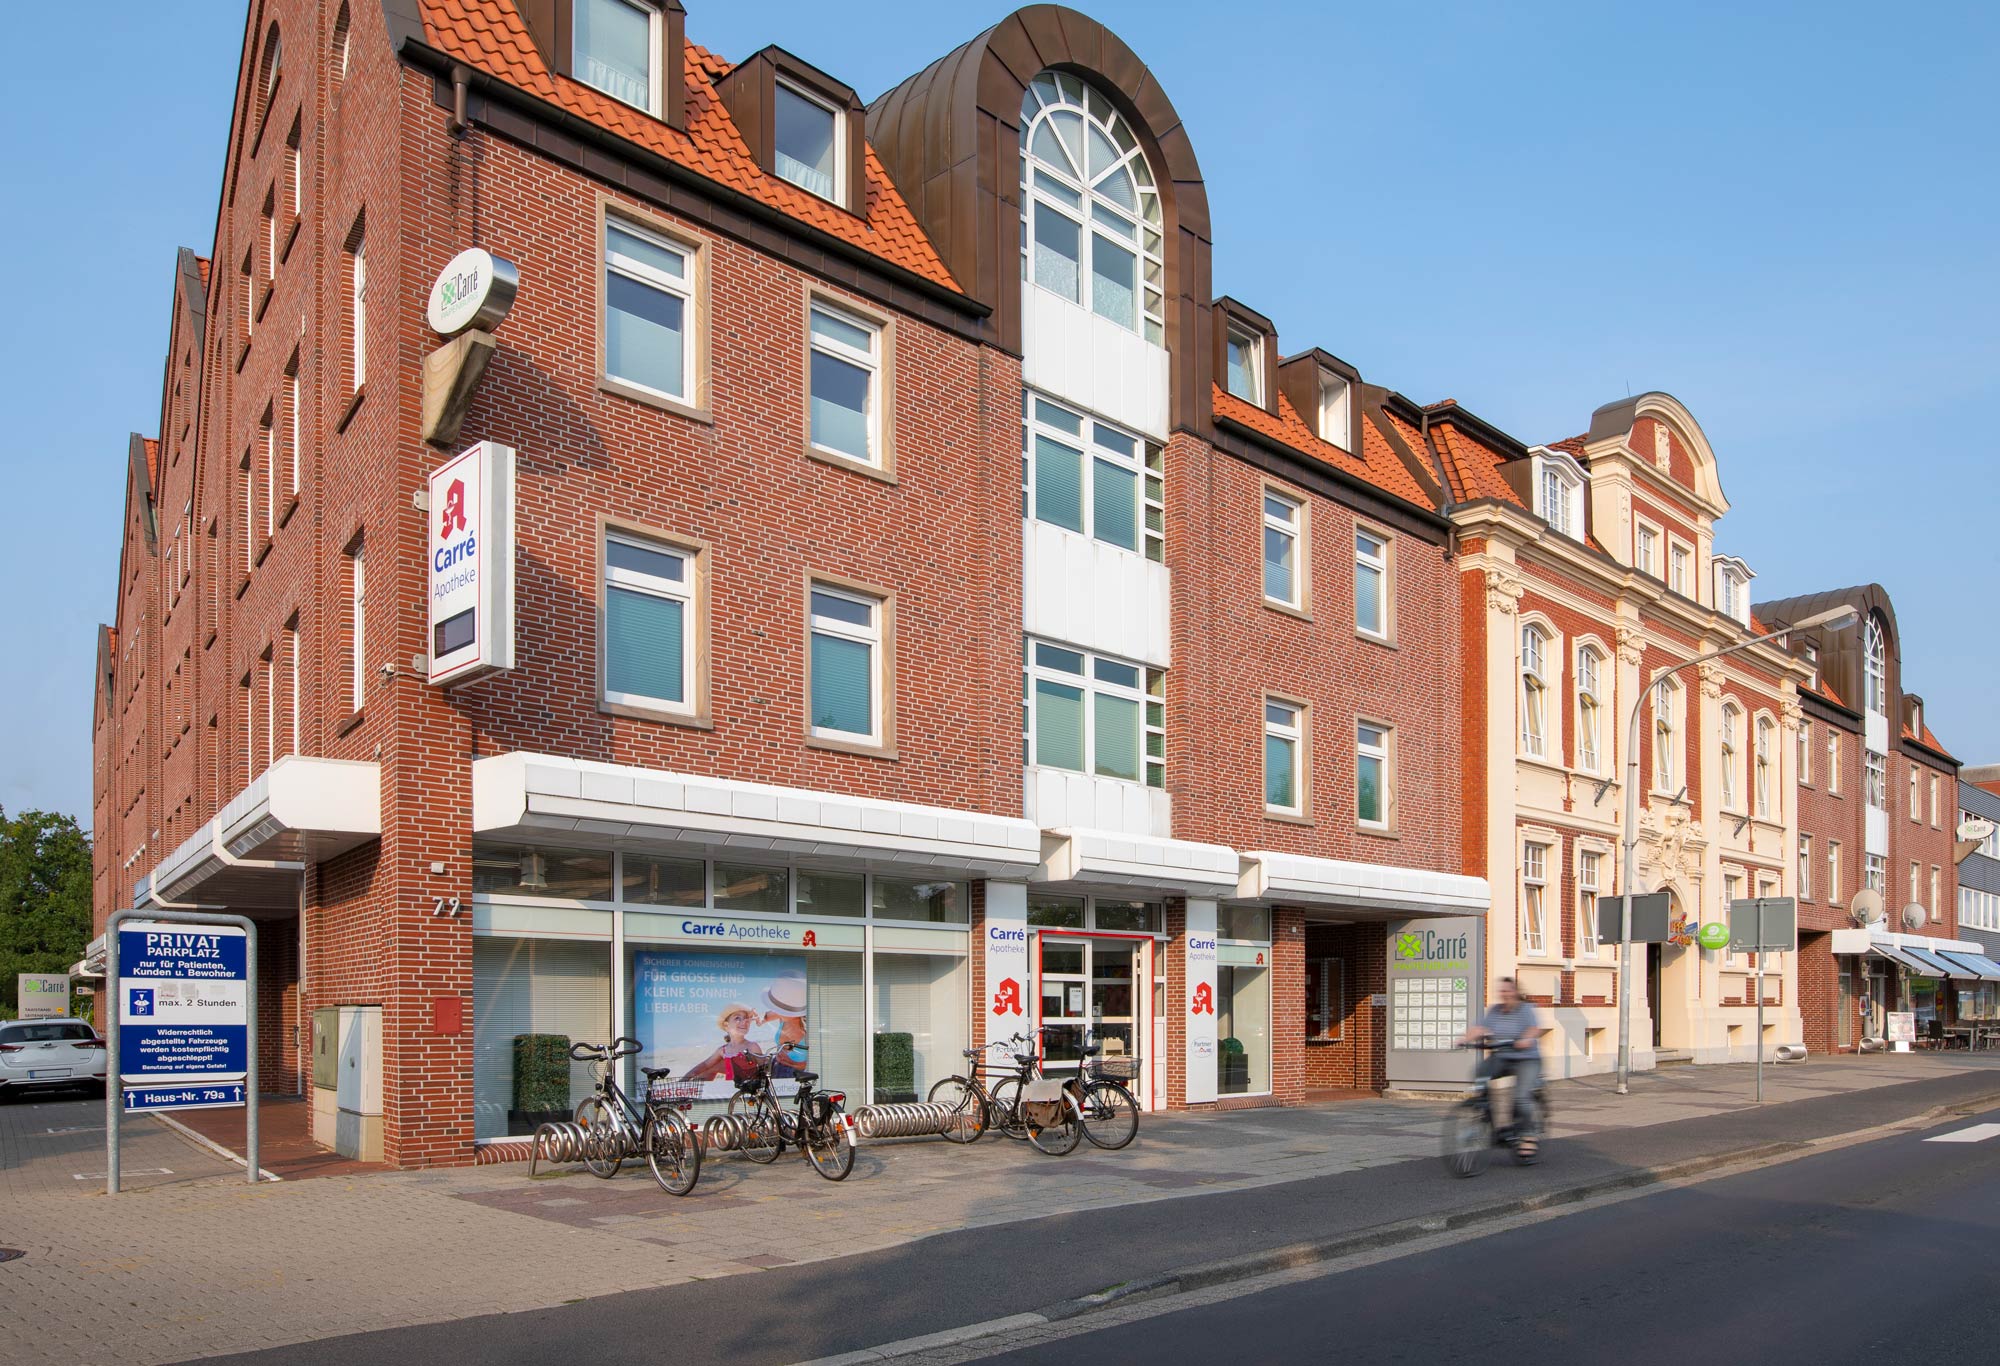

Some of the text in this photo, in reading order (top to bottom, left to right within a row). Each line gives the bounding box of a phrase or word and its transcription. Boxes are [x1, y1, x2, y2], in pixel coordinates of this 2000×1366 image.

[457, 265, 478, 301] Carré
[434, 530, 476, 573] Carré
[434, 567, 476, 600] Apotheke
[432, 896, 460, 917] 79
[681, 921, 791, 941] Carré Apotheke
[990, 927, 1025, 941] Carré
[146, 933, 221, 949] PRIVAT
[1189, 937, 1216, 950] Carré
[1426, 930, 1467, 960] Carré
[147, 947, 220, 958] PARKPLATZ
[989, 944, 1025, 955] Apotheke
[643, 957, 745, 969] SICHERER SONNENSCHUTZ
[1189, 952, 1216, 961] Apotheke
[140, 960, 226, 971] nur für Patienten,
[133, 967, 172, 976] Kunden
[188, 969, 236, 978] Bewohner
[644, 969, 745, 984] FÜR GROSSE UND
[42, 979, 65, 993] Carré
[644, 986, 742, 999] KLEINE SONNEN-
[159, 999, 237, 1007] max. 2 Stunden
[645, 1001, 709, 1014] LIEBHABER
[157, 1028, 213, 1036] Widerrechtlich
[141, 1037, 228, 1046] abgestellte Fahrzeuge
[172, 1045, 230, 1054] kostenpflichtig
[157, 1054, 213, 1063] abgeschleppt!
[145, 1090, 225, 1103] Haus-Nr. 79a
